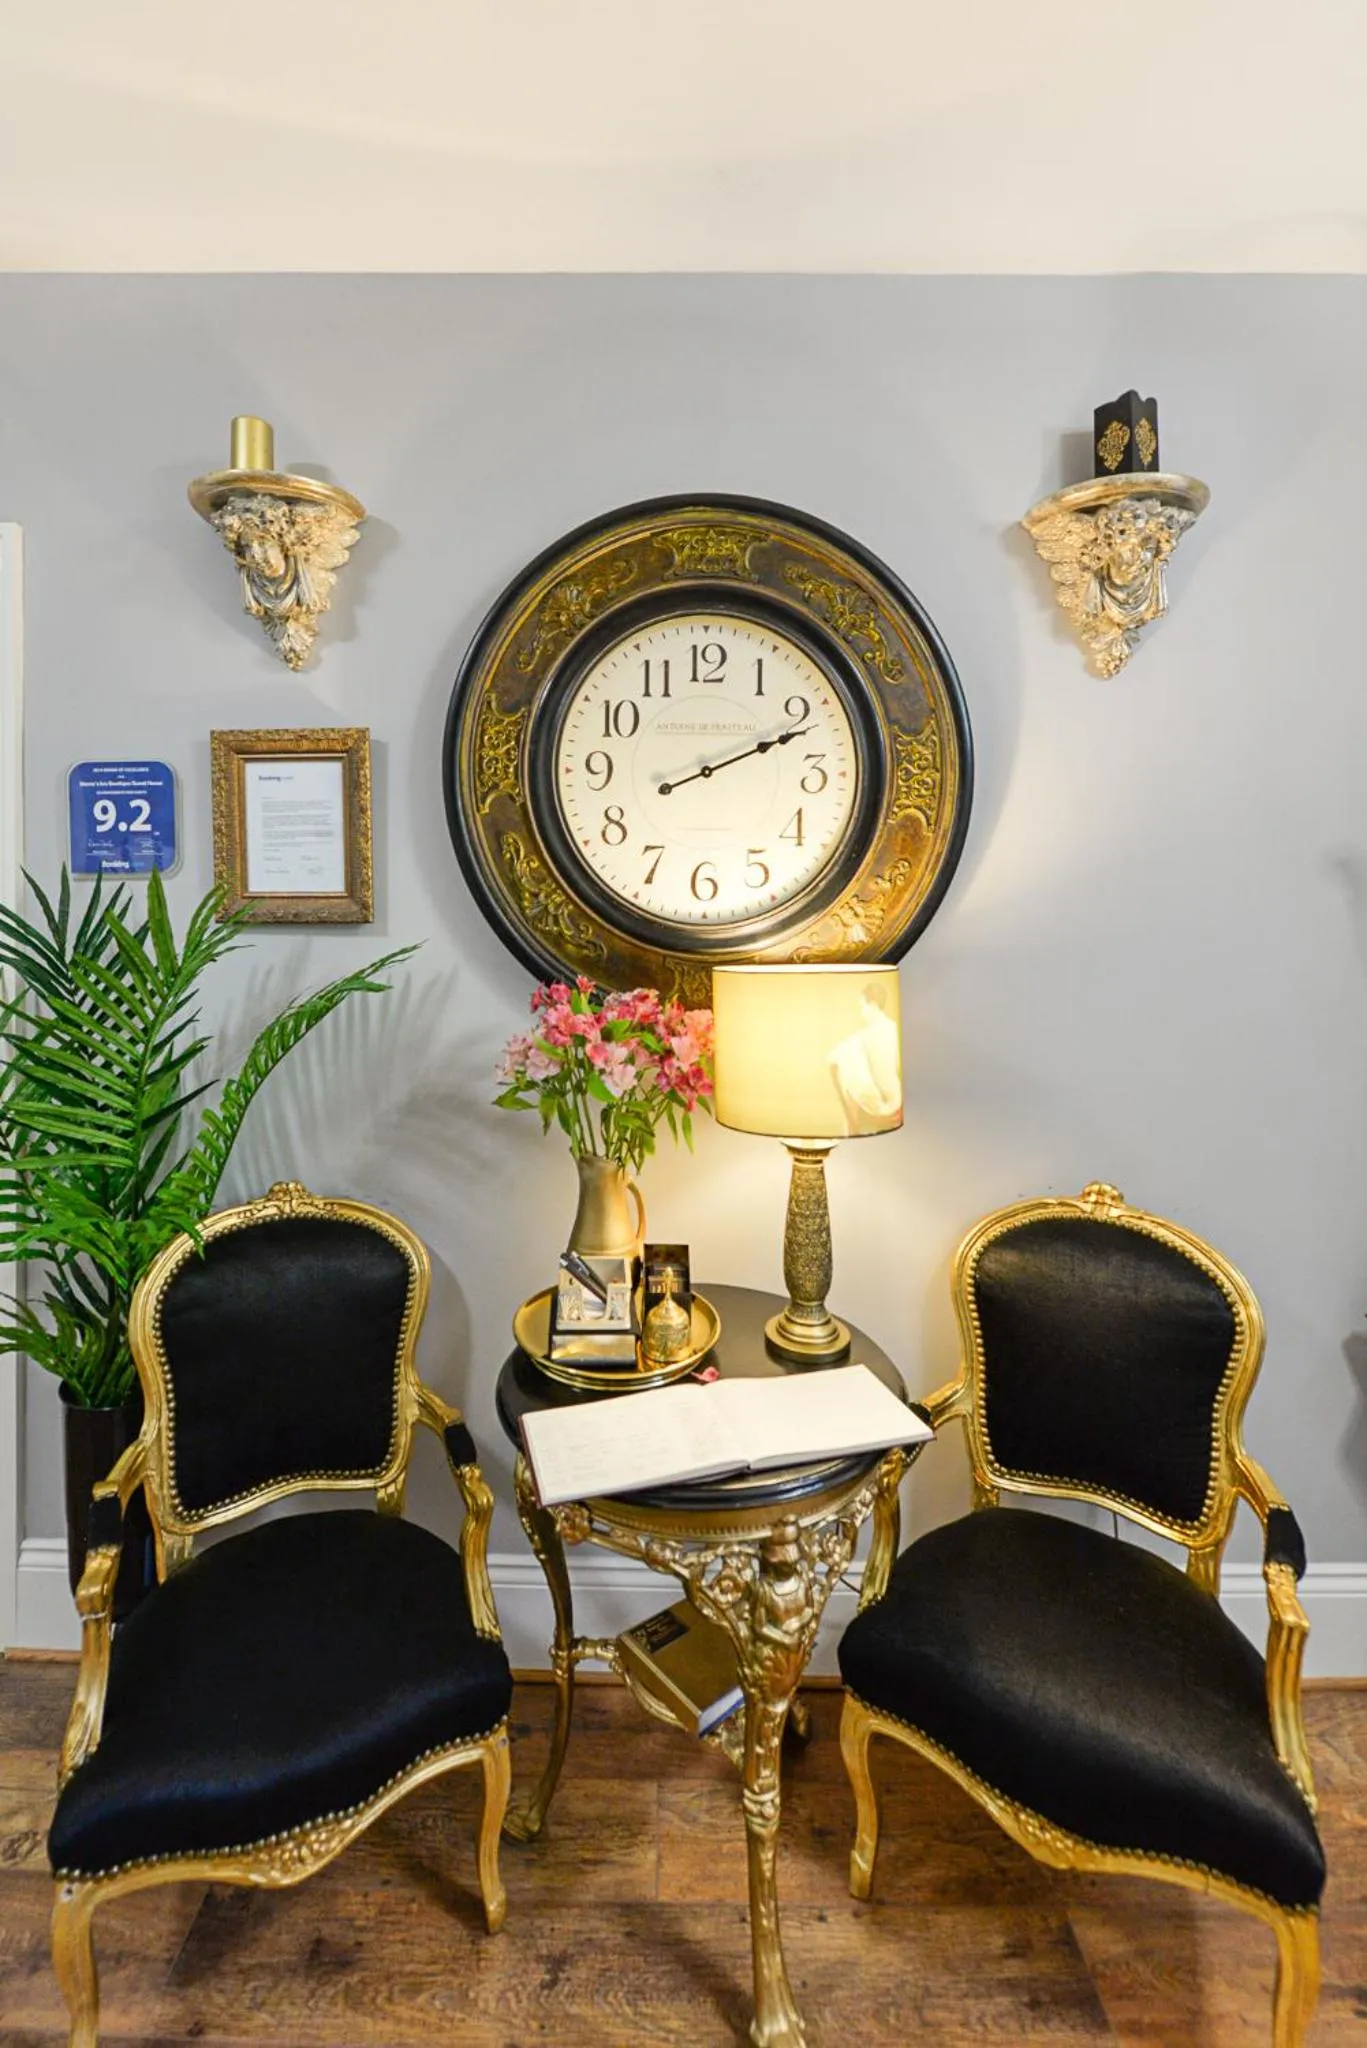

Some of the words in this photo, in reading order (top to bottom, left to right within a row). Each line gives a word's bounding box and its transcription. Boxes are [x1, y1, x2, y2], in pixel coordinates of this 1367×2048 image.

[639, 659, 672, 698] 11
[688, 643, 727, 683] 12
[753, 658, 766, 696] 1
[600, 700, 640, 738] 10
[585, 751, 613, 791] 9
[800, 754, 828, 793] 3
[93, 799, 152, 833] 9.2
[601, 805, 627, 846] 8
[779, 808, 805, 846] 4
[642, 845, 665, 884] 7
[690, 861, 718, 901] 6
[744, 849, 769, 888] 5
